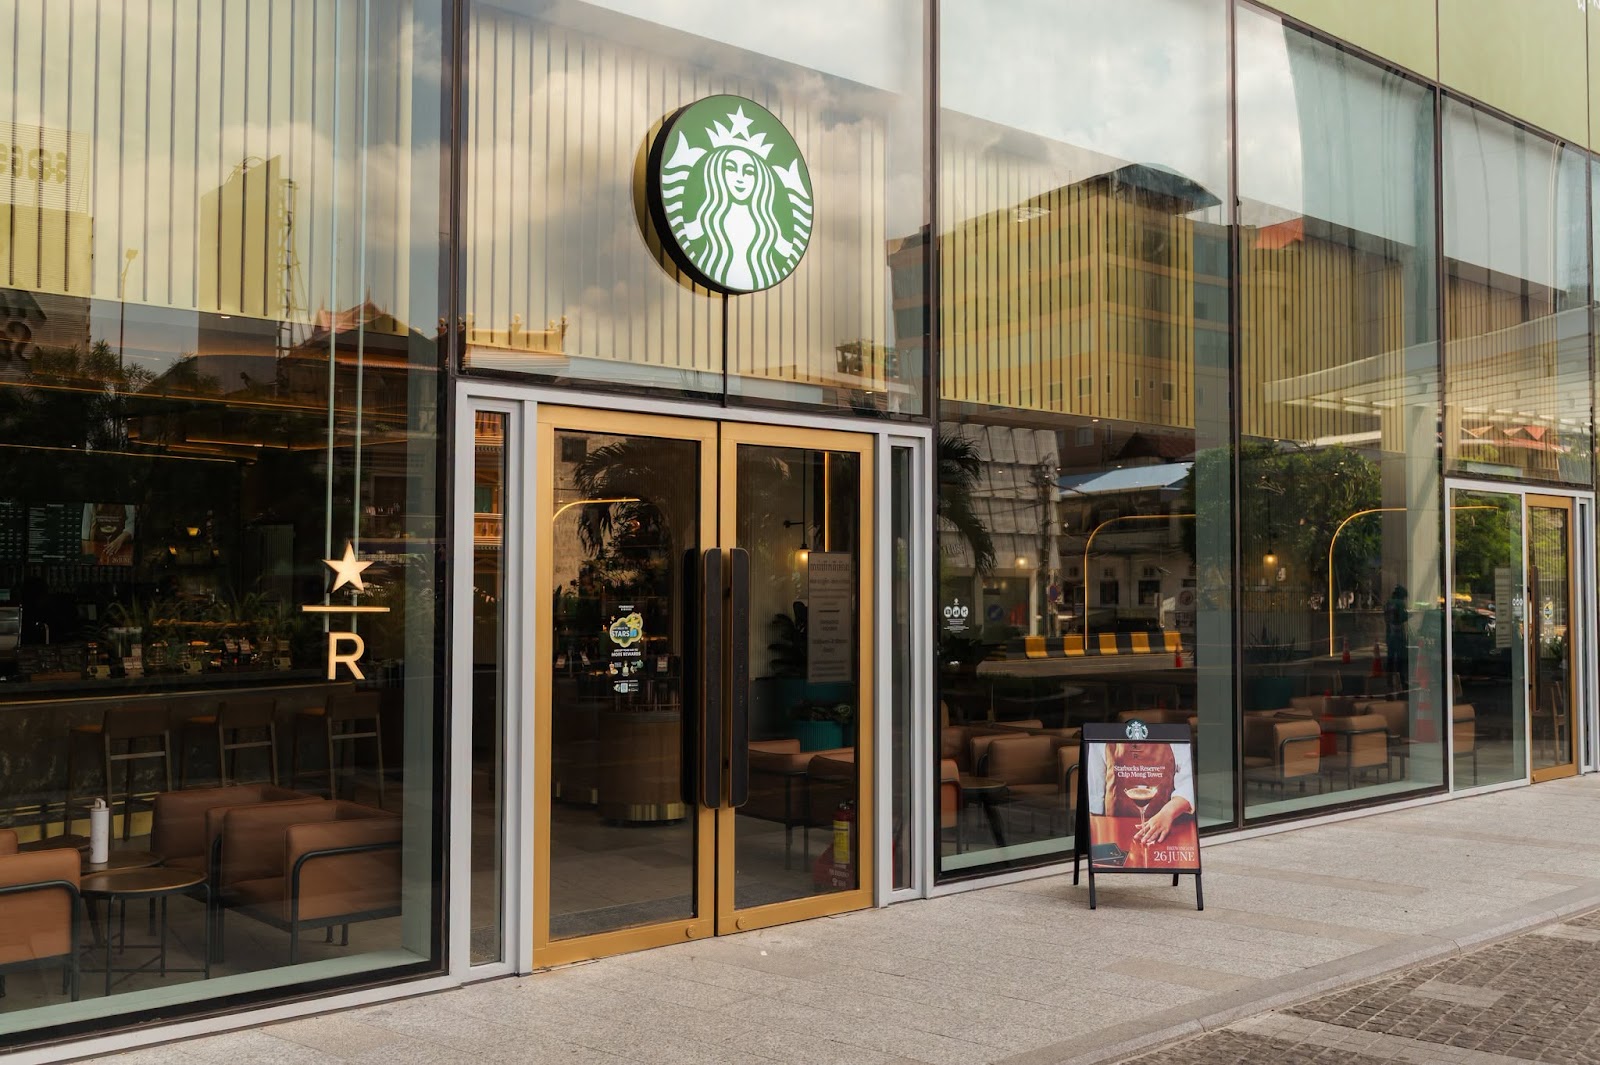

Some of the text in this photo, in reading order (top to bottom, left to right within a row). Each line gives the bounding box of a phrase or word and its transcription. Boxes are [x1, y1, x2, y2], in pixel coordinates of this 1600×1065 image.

[328, 632, 366, 680] R
[1154, 850, 1195, 864] 26 JUNE
